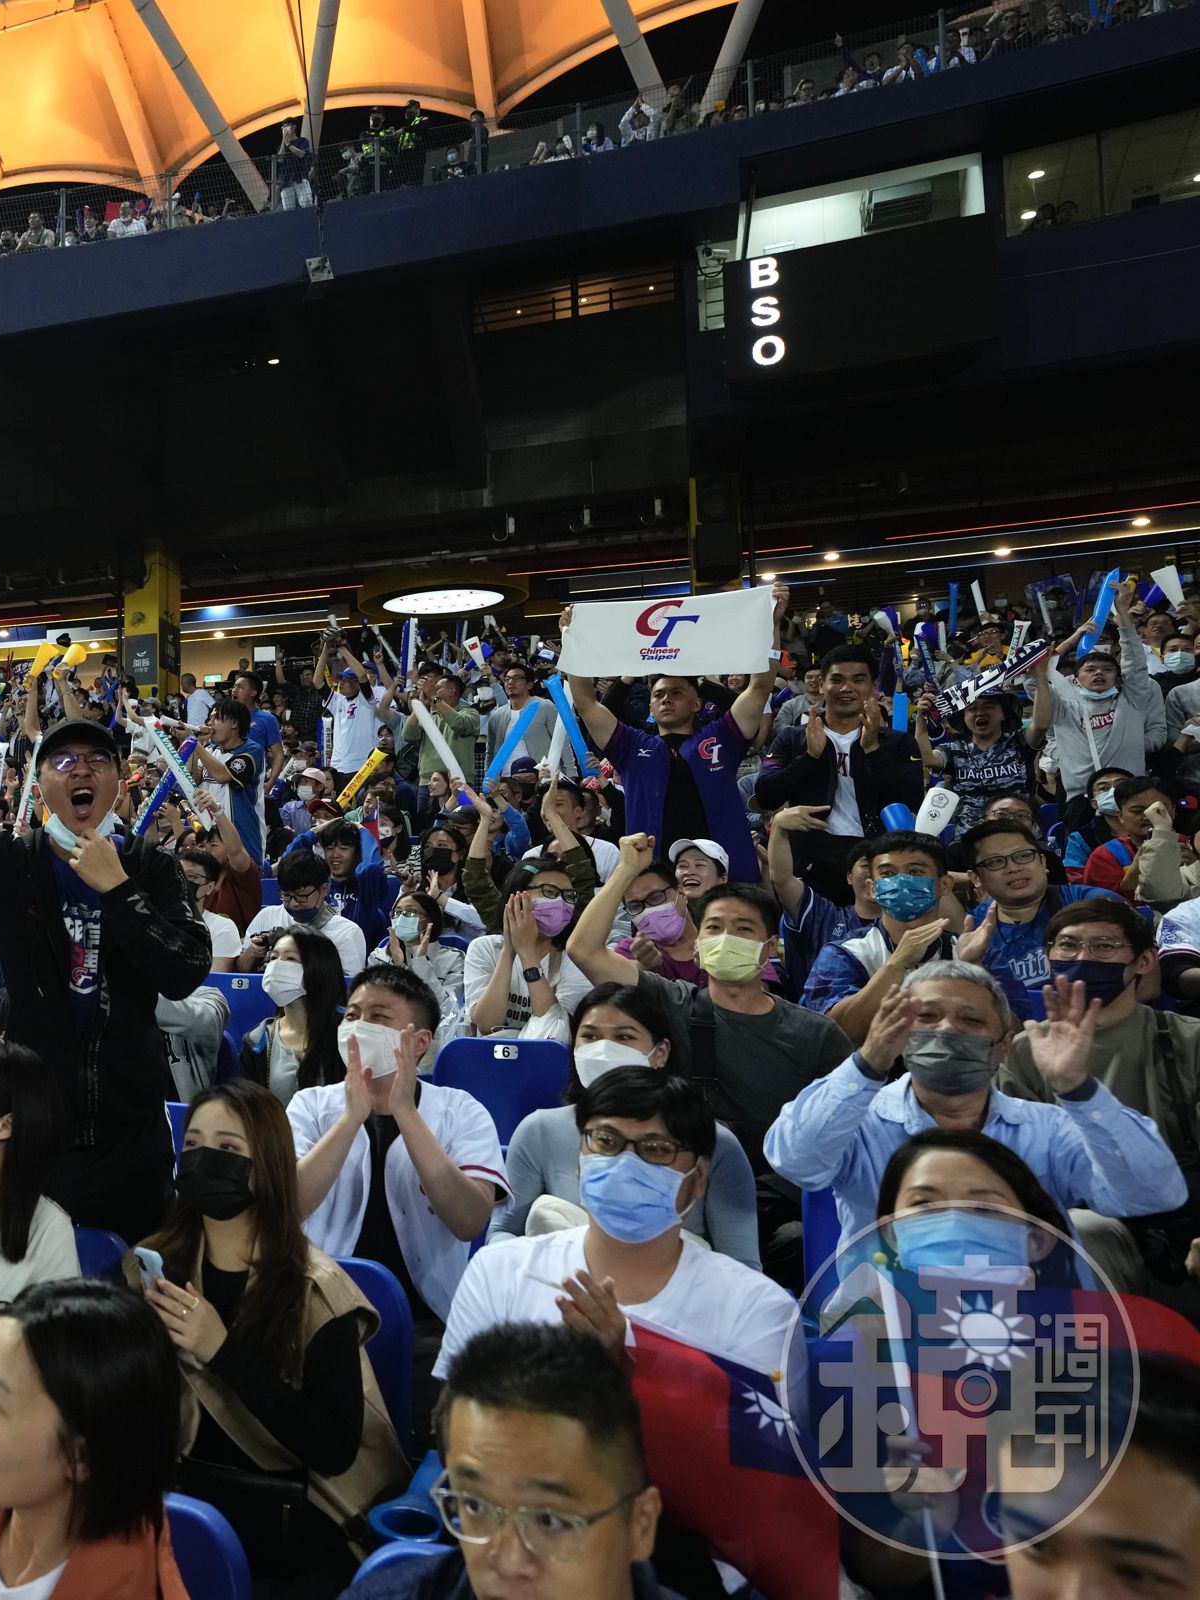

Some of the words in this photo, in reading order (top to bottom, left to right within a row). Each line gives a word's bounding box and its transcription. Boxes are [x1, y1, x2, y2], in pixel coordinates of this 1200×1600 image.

[750, 256, 779, 289] B
[751, 296, 781, 327] S
[752, 335, 785, 366] O
[237, 979, 244, 989] 9
[502, 1046, 511, 1058] 6
